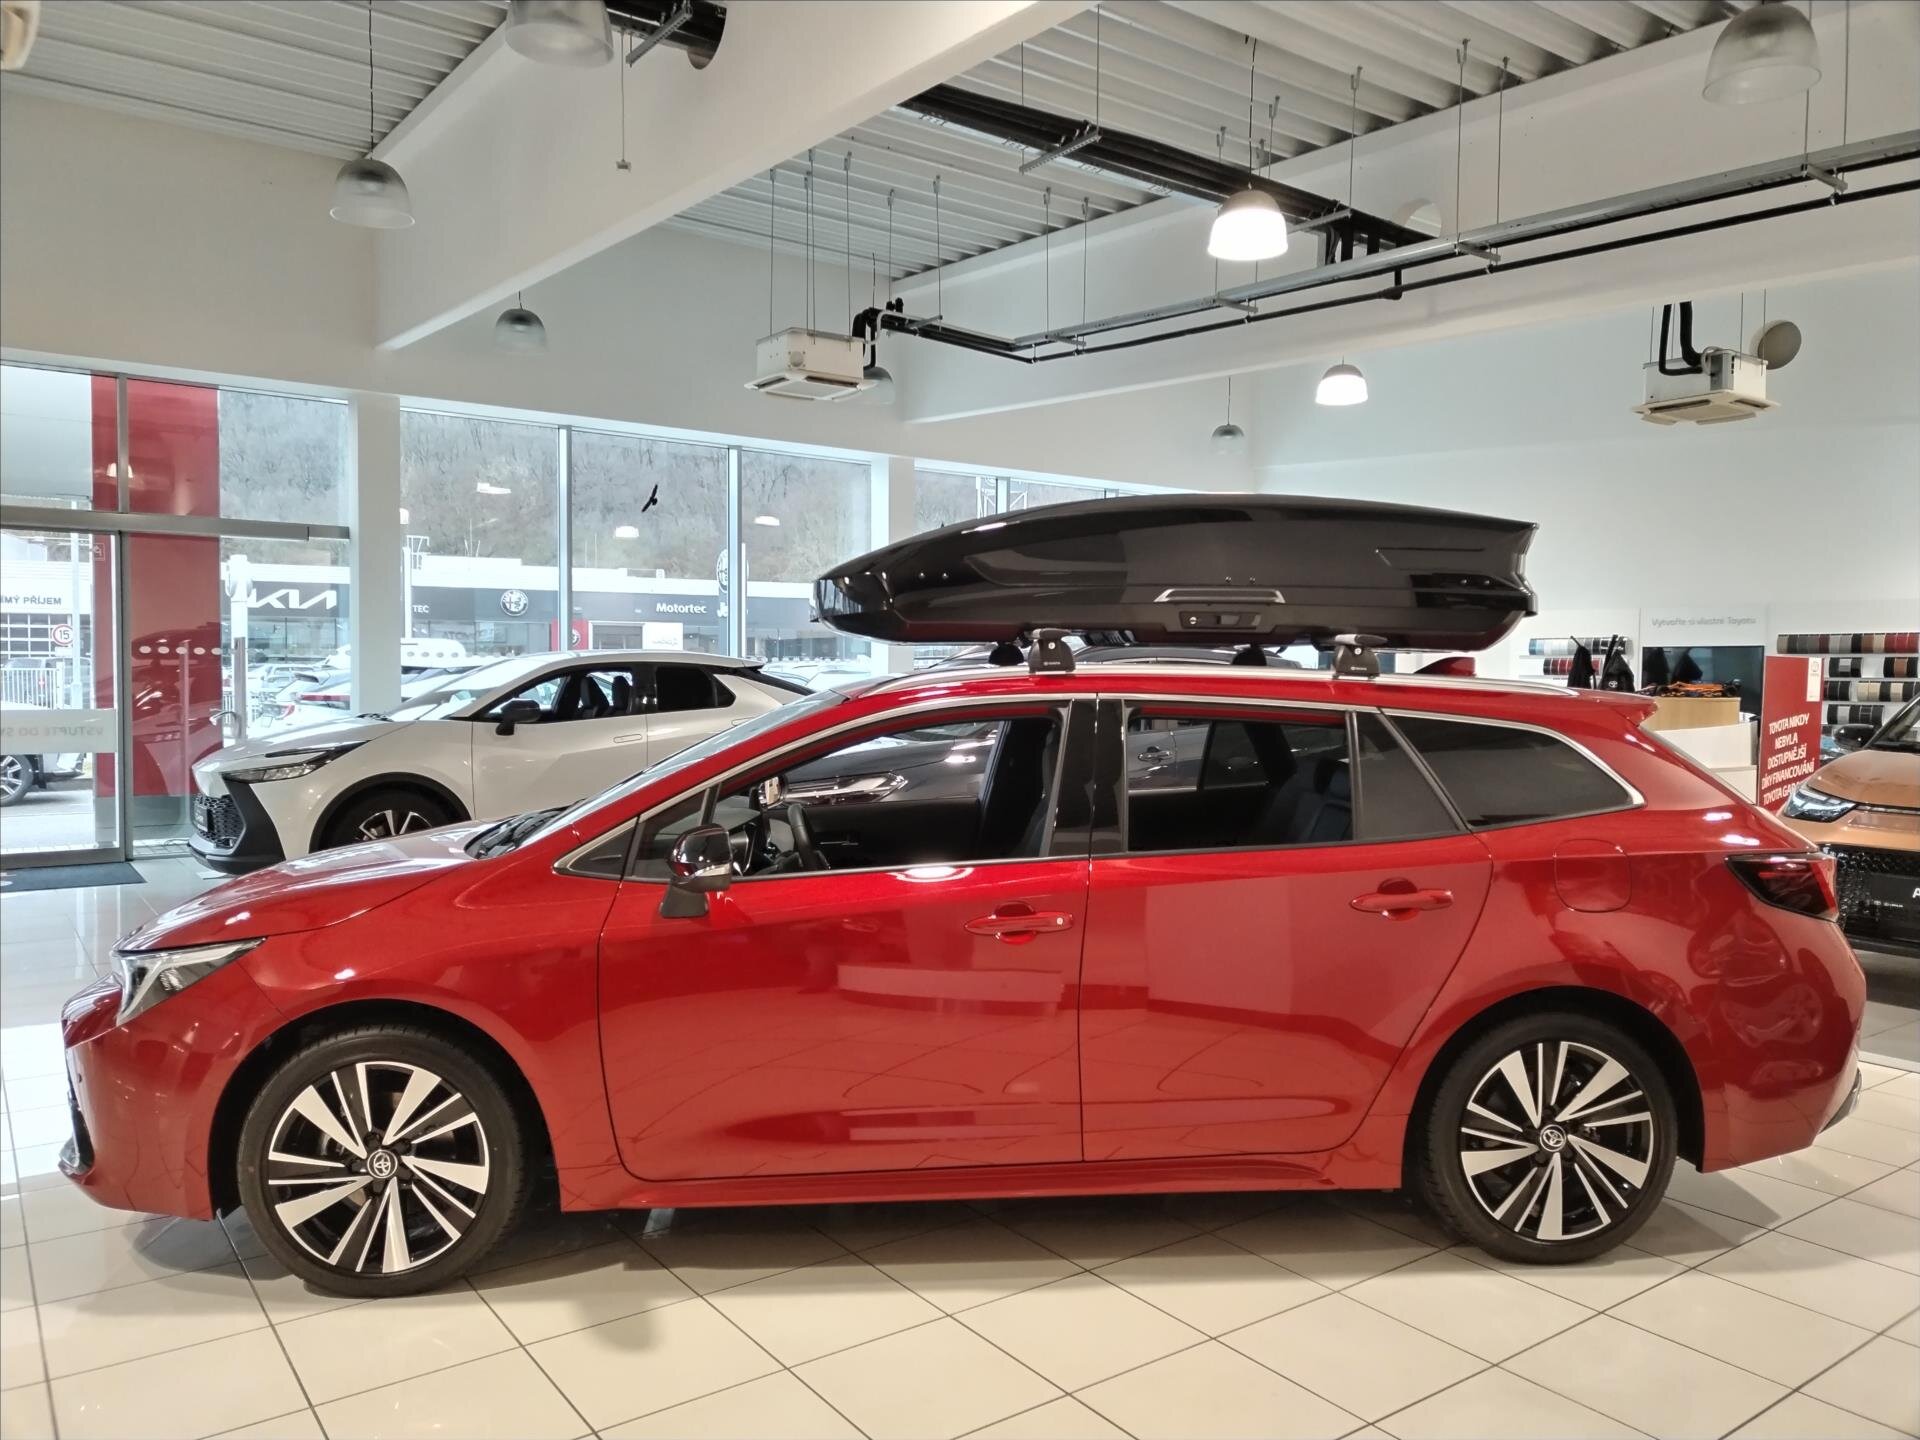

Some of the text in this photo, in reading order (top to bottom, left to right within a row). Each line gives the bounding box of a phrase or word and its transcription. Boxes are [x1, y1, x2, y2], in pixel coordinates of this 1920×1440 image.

[23, 595, 62, 605] PŘÍJEM
[656, 602, 707, 614] Motortec
[59, 629, 70, 640] 15
[1769, 712, 1809, 735] TOYOTA NIKDY
[1775, 732, 1798, 750] NEBYLA
[1767, 743, 1807, 770] DOSTUPNĚJŠÍ
[1763, 787, 1782, 806] TOYOTA
